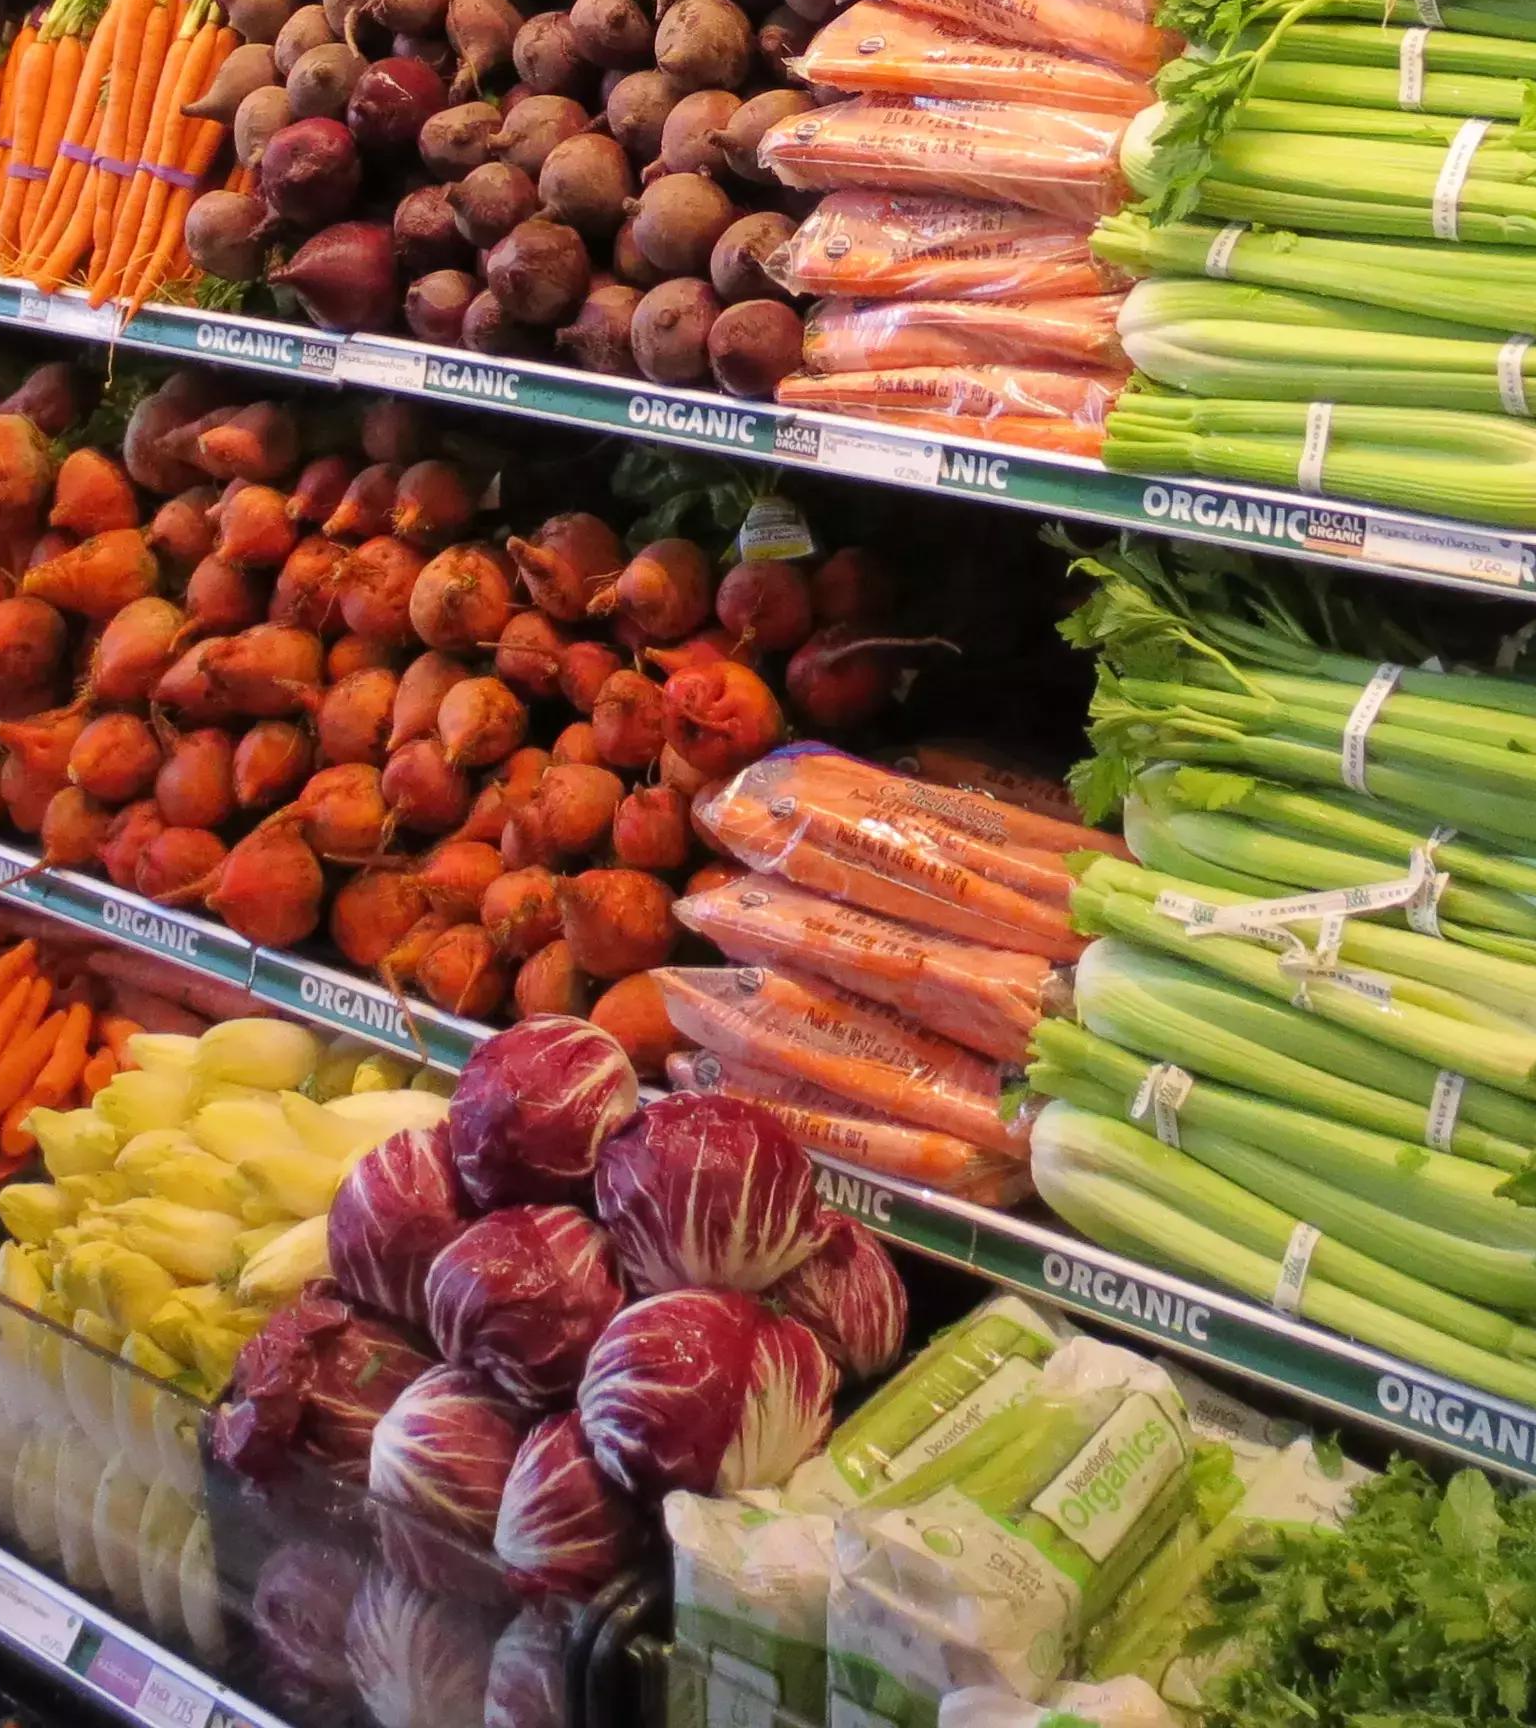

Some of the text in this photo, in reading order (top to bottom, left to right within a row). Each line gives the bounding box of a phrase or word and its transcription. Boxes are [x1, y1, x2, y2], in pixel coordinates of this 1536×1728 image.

[196, 323, 295, 364] ORGANIC
[303, 343, 336, 360] LOCAL
[425, 358, 521, 401] RGANIC
[627, 394, 758, 445] ORGANIC
[777, 425, 819, 446] LOCAL
[776, 436, 818, 456] ORGANIC
[1143, 485, 1307, 543] ORGANIC
[1308, 524, 1363, 546] ORGANIC
[1310, 510, 1363, 533] LOCAL
[102, 898, 200, 957] ORGANIC
[299, 975, 409, 1040] ORGANIC
[815, 1168, 894, 1223] ANIC
[1042, 1251, 1211, 1342] ORGANIC
[1058, 1419, 1167, 1530] Organics
[1064, 1437, 1117, 1497] Deardorff
